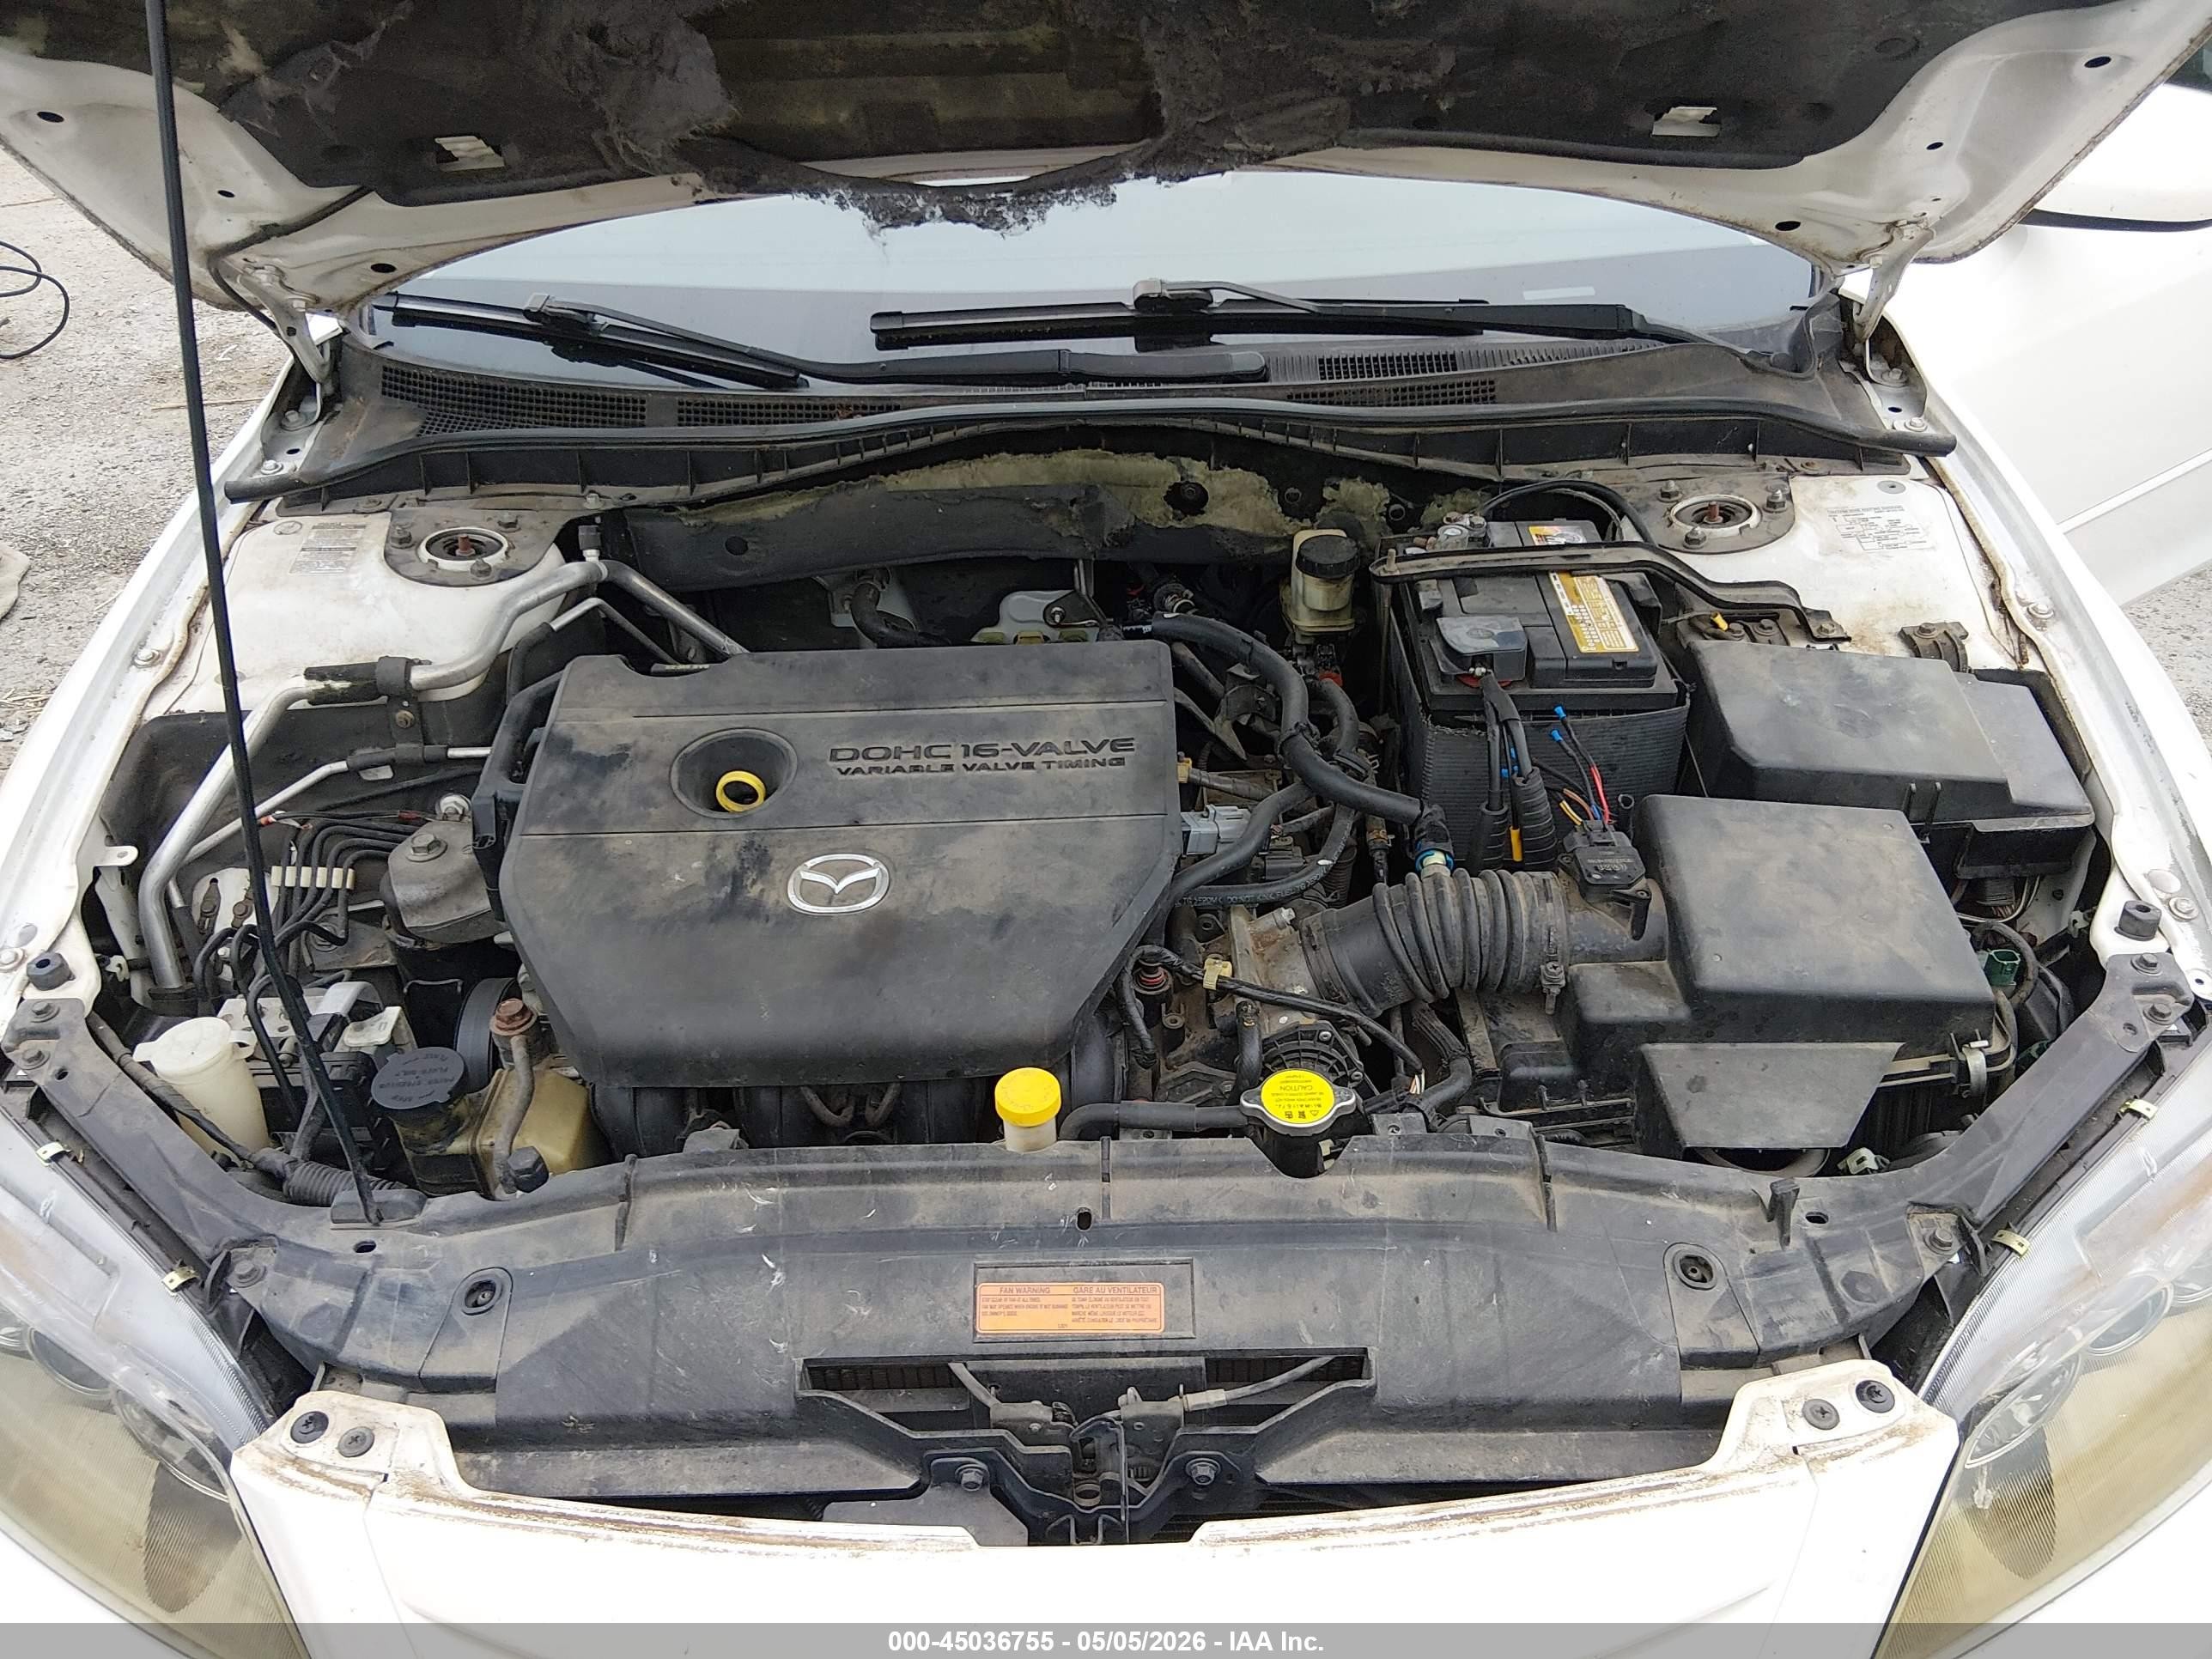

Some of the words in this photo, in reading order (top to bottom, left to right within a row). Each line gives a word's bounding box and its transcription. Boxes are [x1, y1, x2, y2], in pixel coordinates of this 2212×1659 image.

[830, 744, 952, 763] DOHC
[960, 737, 1136, 760] 16-VALVE
[836, 763, 956, 776] VARIABLE
[962, 760, 1036, 773] VALVE
[1041, 757, 1127, 770] TIMING
